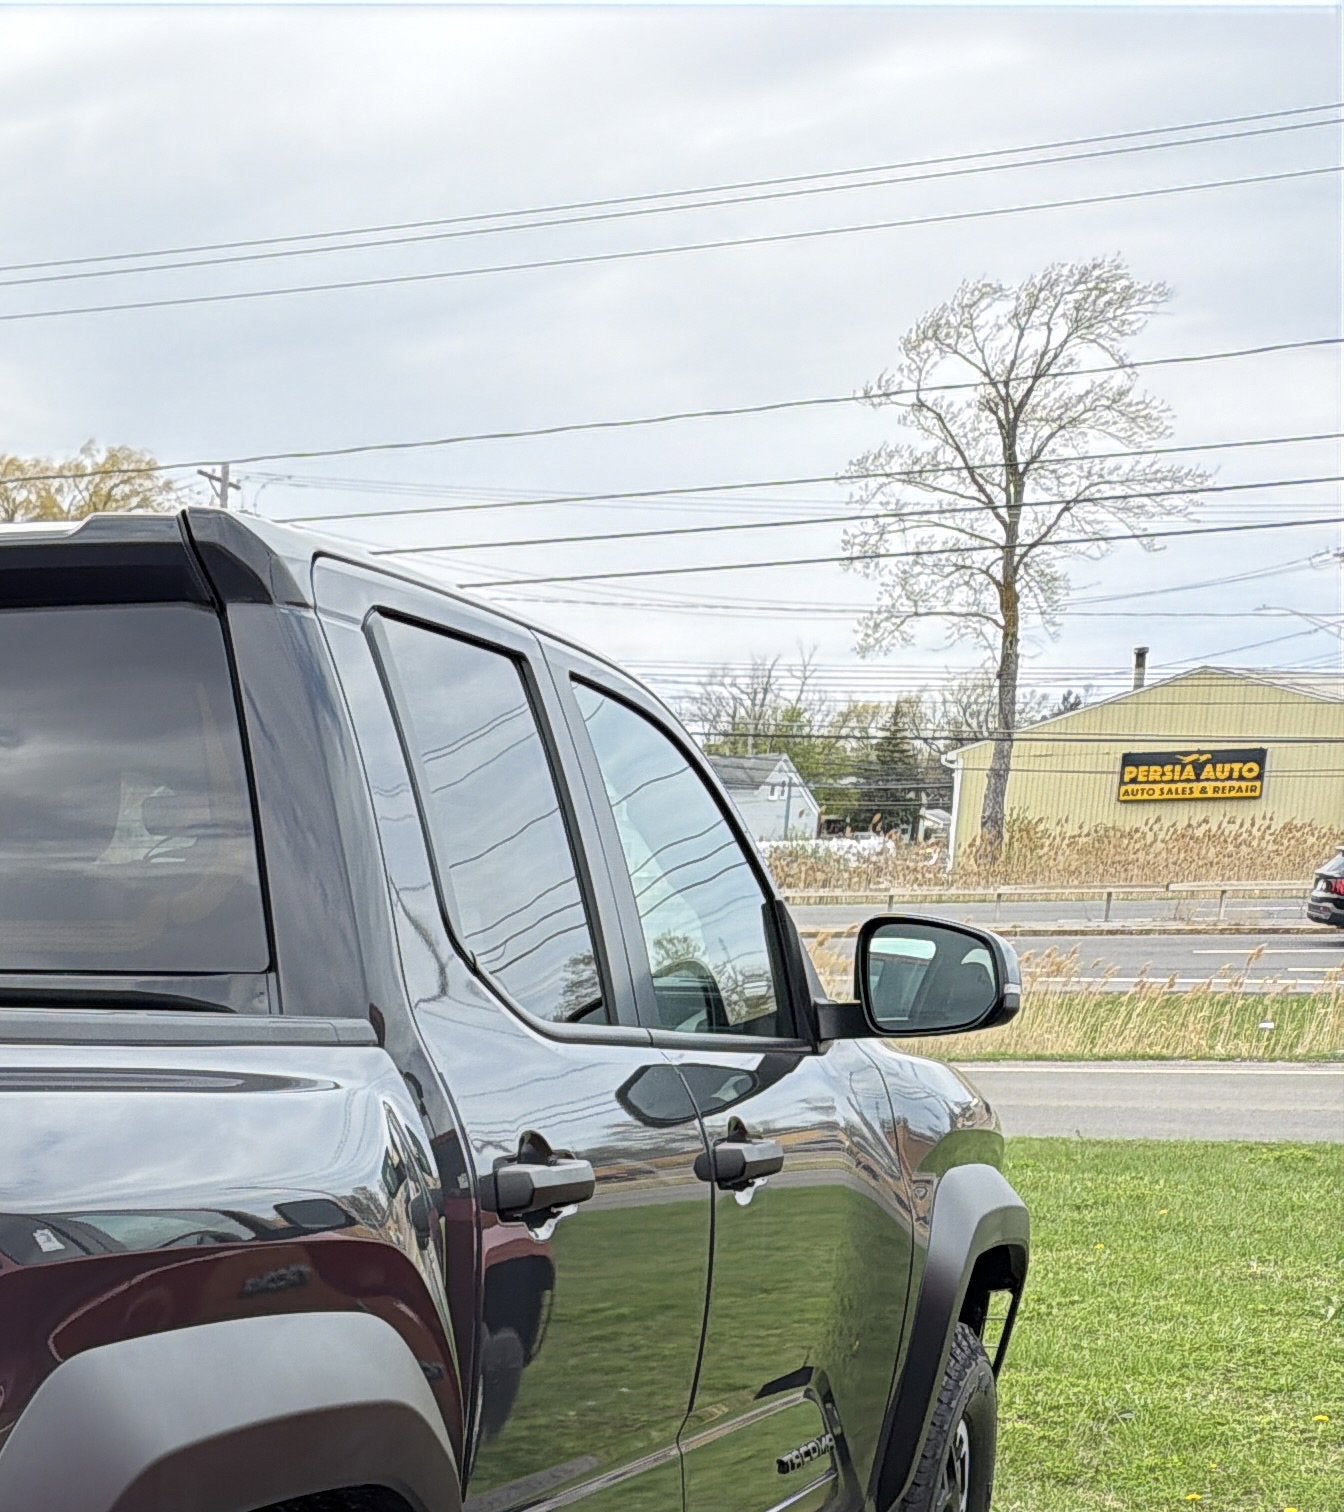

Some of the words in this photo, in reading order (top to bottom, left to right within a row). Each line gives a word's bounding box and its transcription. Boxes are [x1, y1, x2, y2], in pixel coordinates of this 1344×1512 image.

[1123, 764, 1196, 782] PERSIA
[1199, 762, 1260, 780] AUTO
[1122, 787, 1155, 797] AUTO
[1158, 786, 1194, 796] SALES
[1199, 785, 1208, 795] &
[1212, 784, 1257, 795] REPAIR
[776, 1433, 835, 1474] TACOMA
